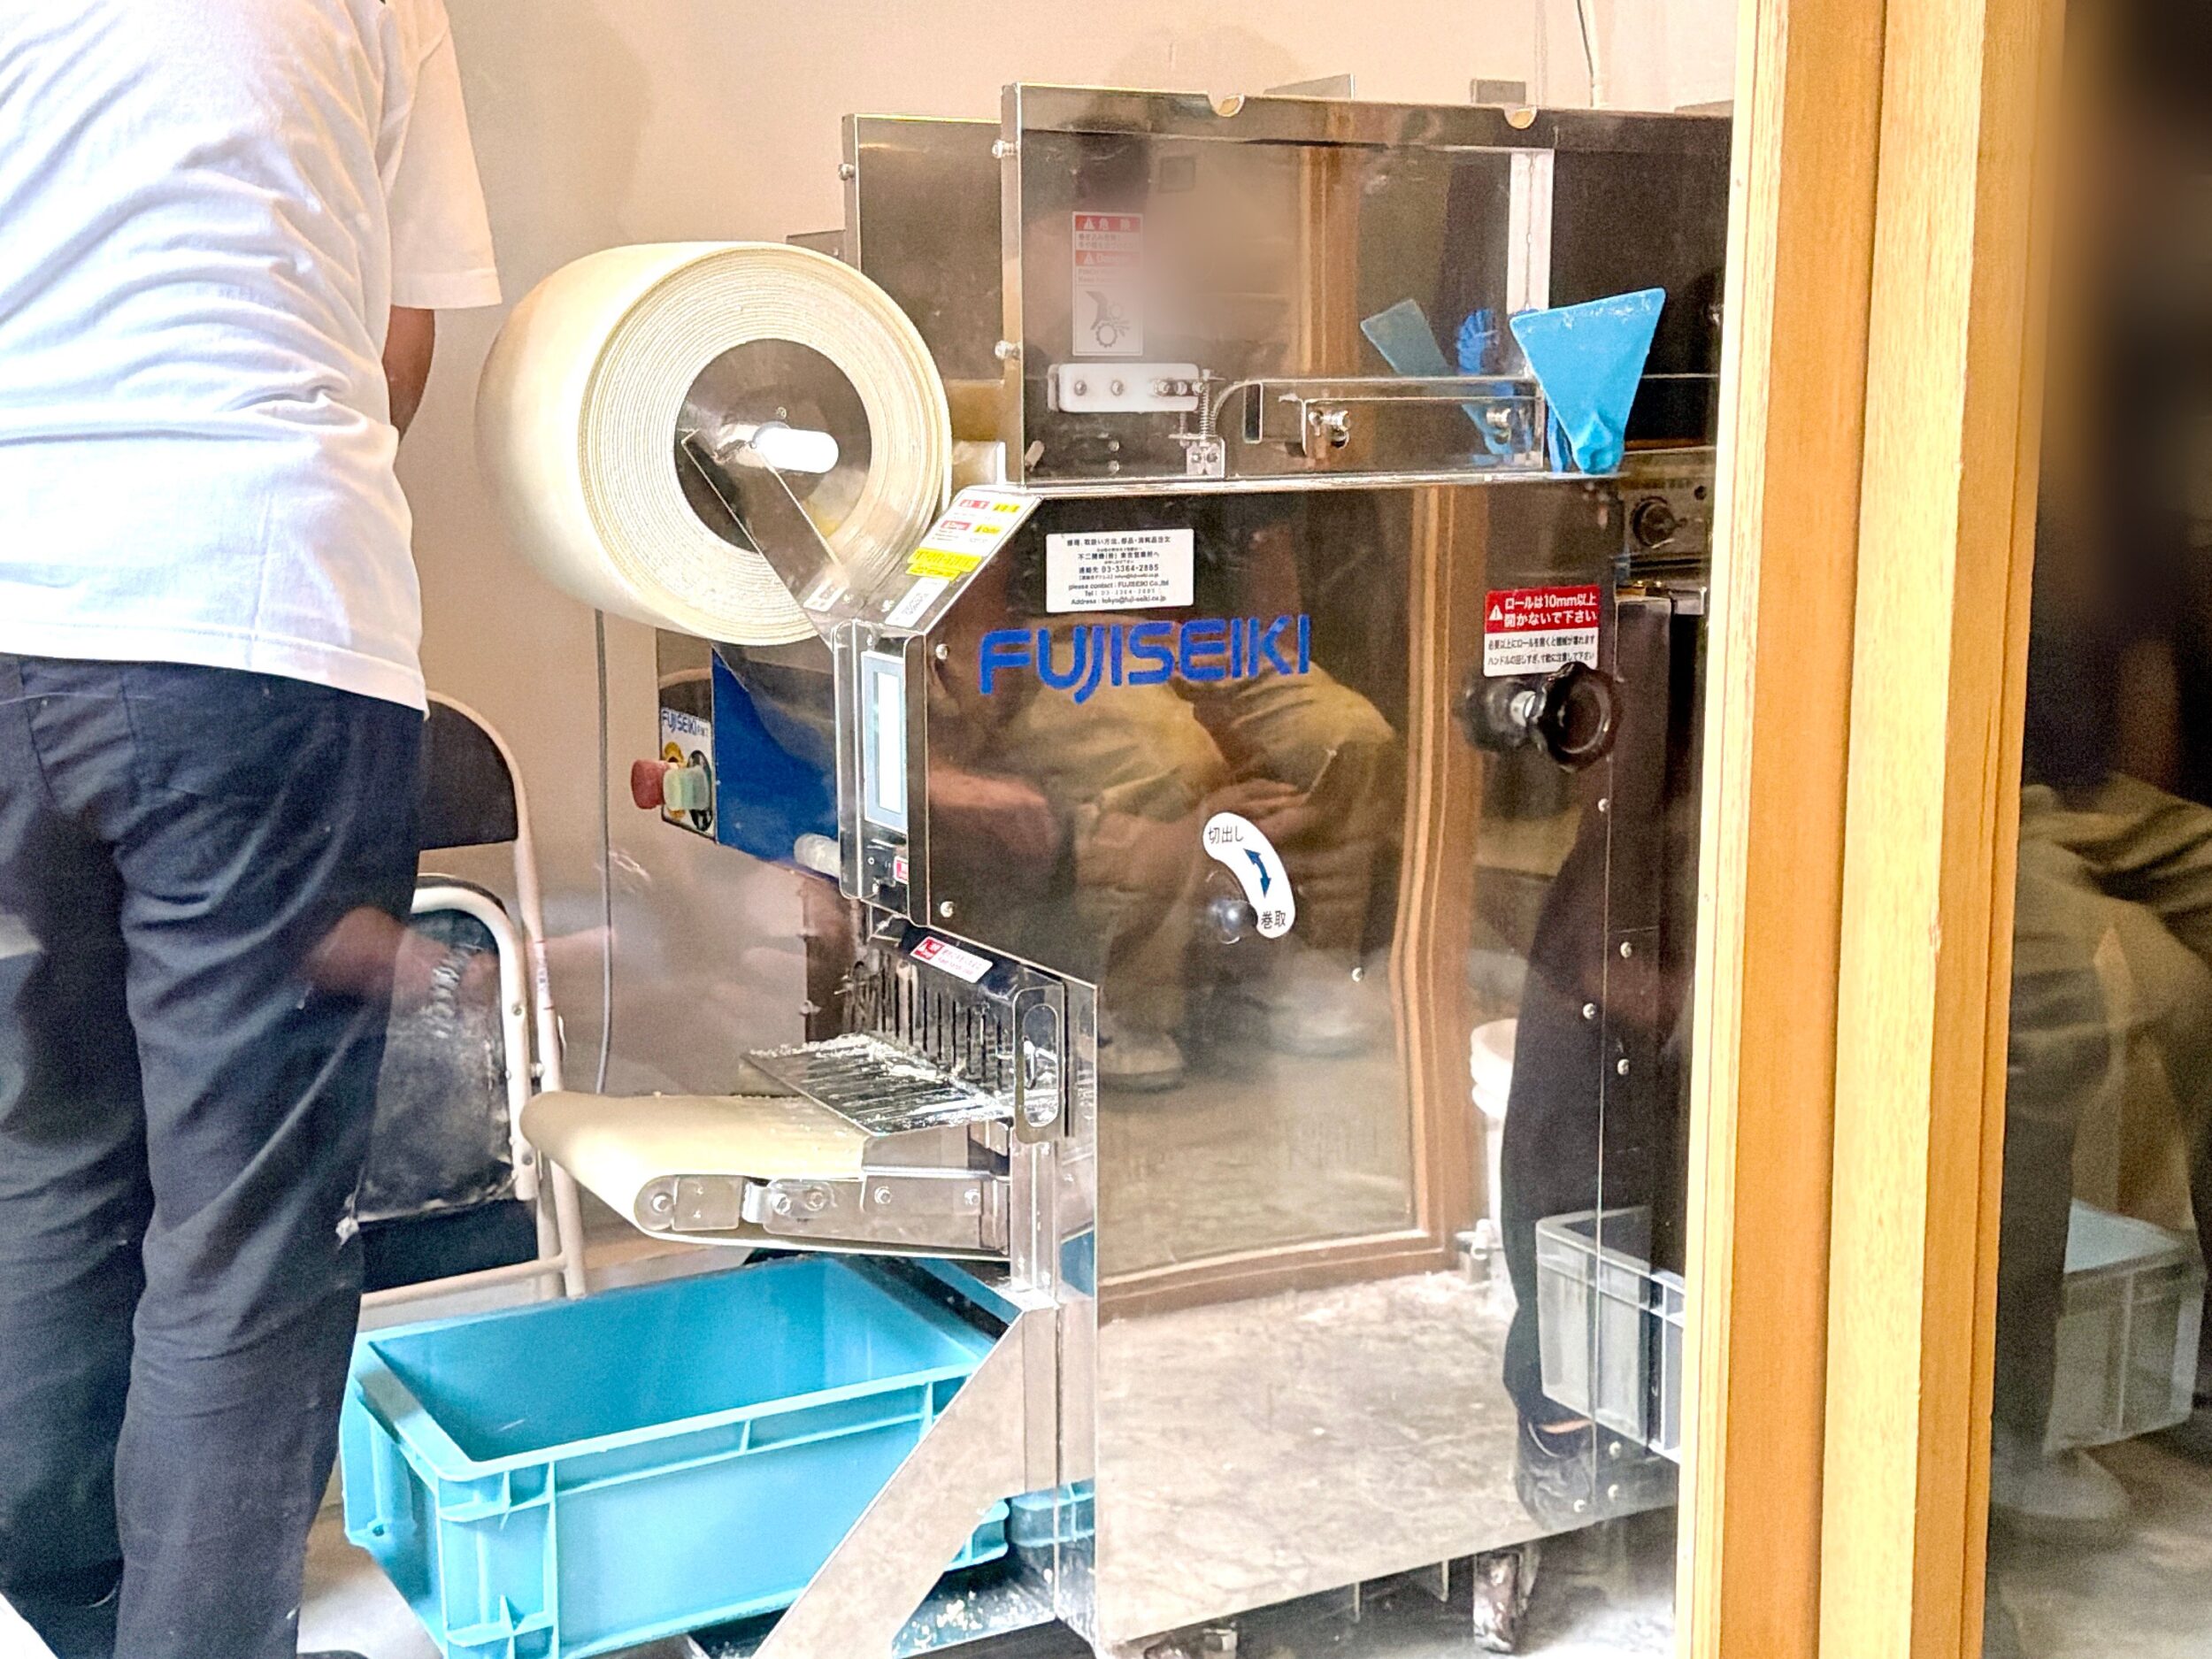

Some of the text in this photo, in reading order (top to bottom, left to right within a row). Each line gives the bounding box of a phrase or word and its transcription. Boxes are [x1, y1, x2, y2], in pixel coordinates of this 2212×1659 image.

[1505, 592, 1597, 611] ロールは10mm以上
[1504, 610, 1597, 628] 開かないで下さい
[979, 614, 1310, 704] FUJISEIKI
[662, 710, 696, 735] FUJISEIKI
[1209, 826, 1244, 844] 切出し
[1261, 910, 1286, 929] 巻取
